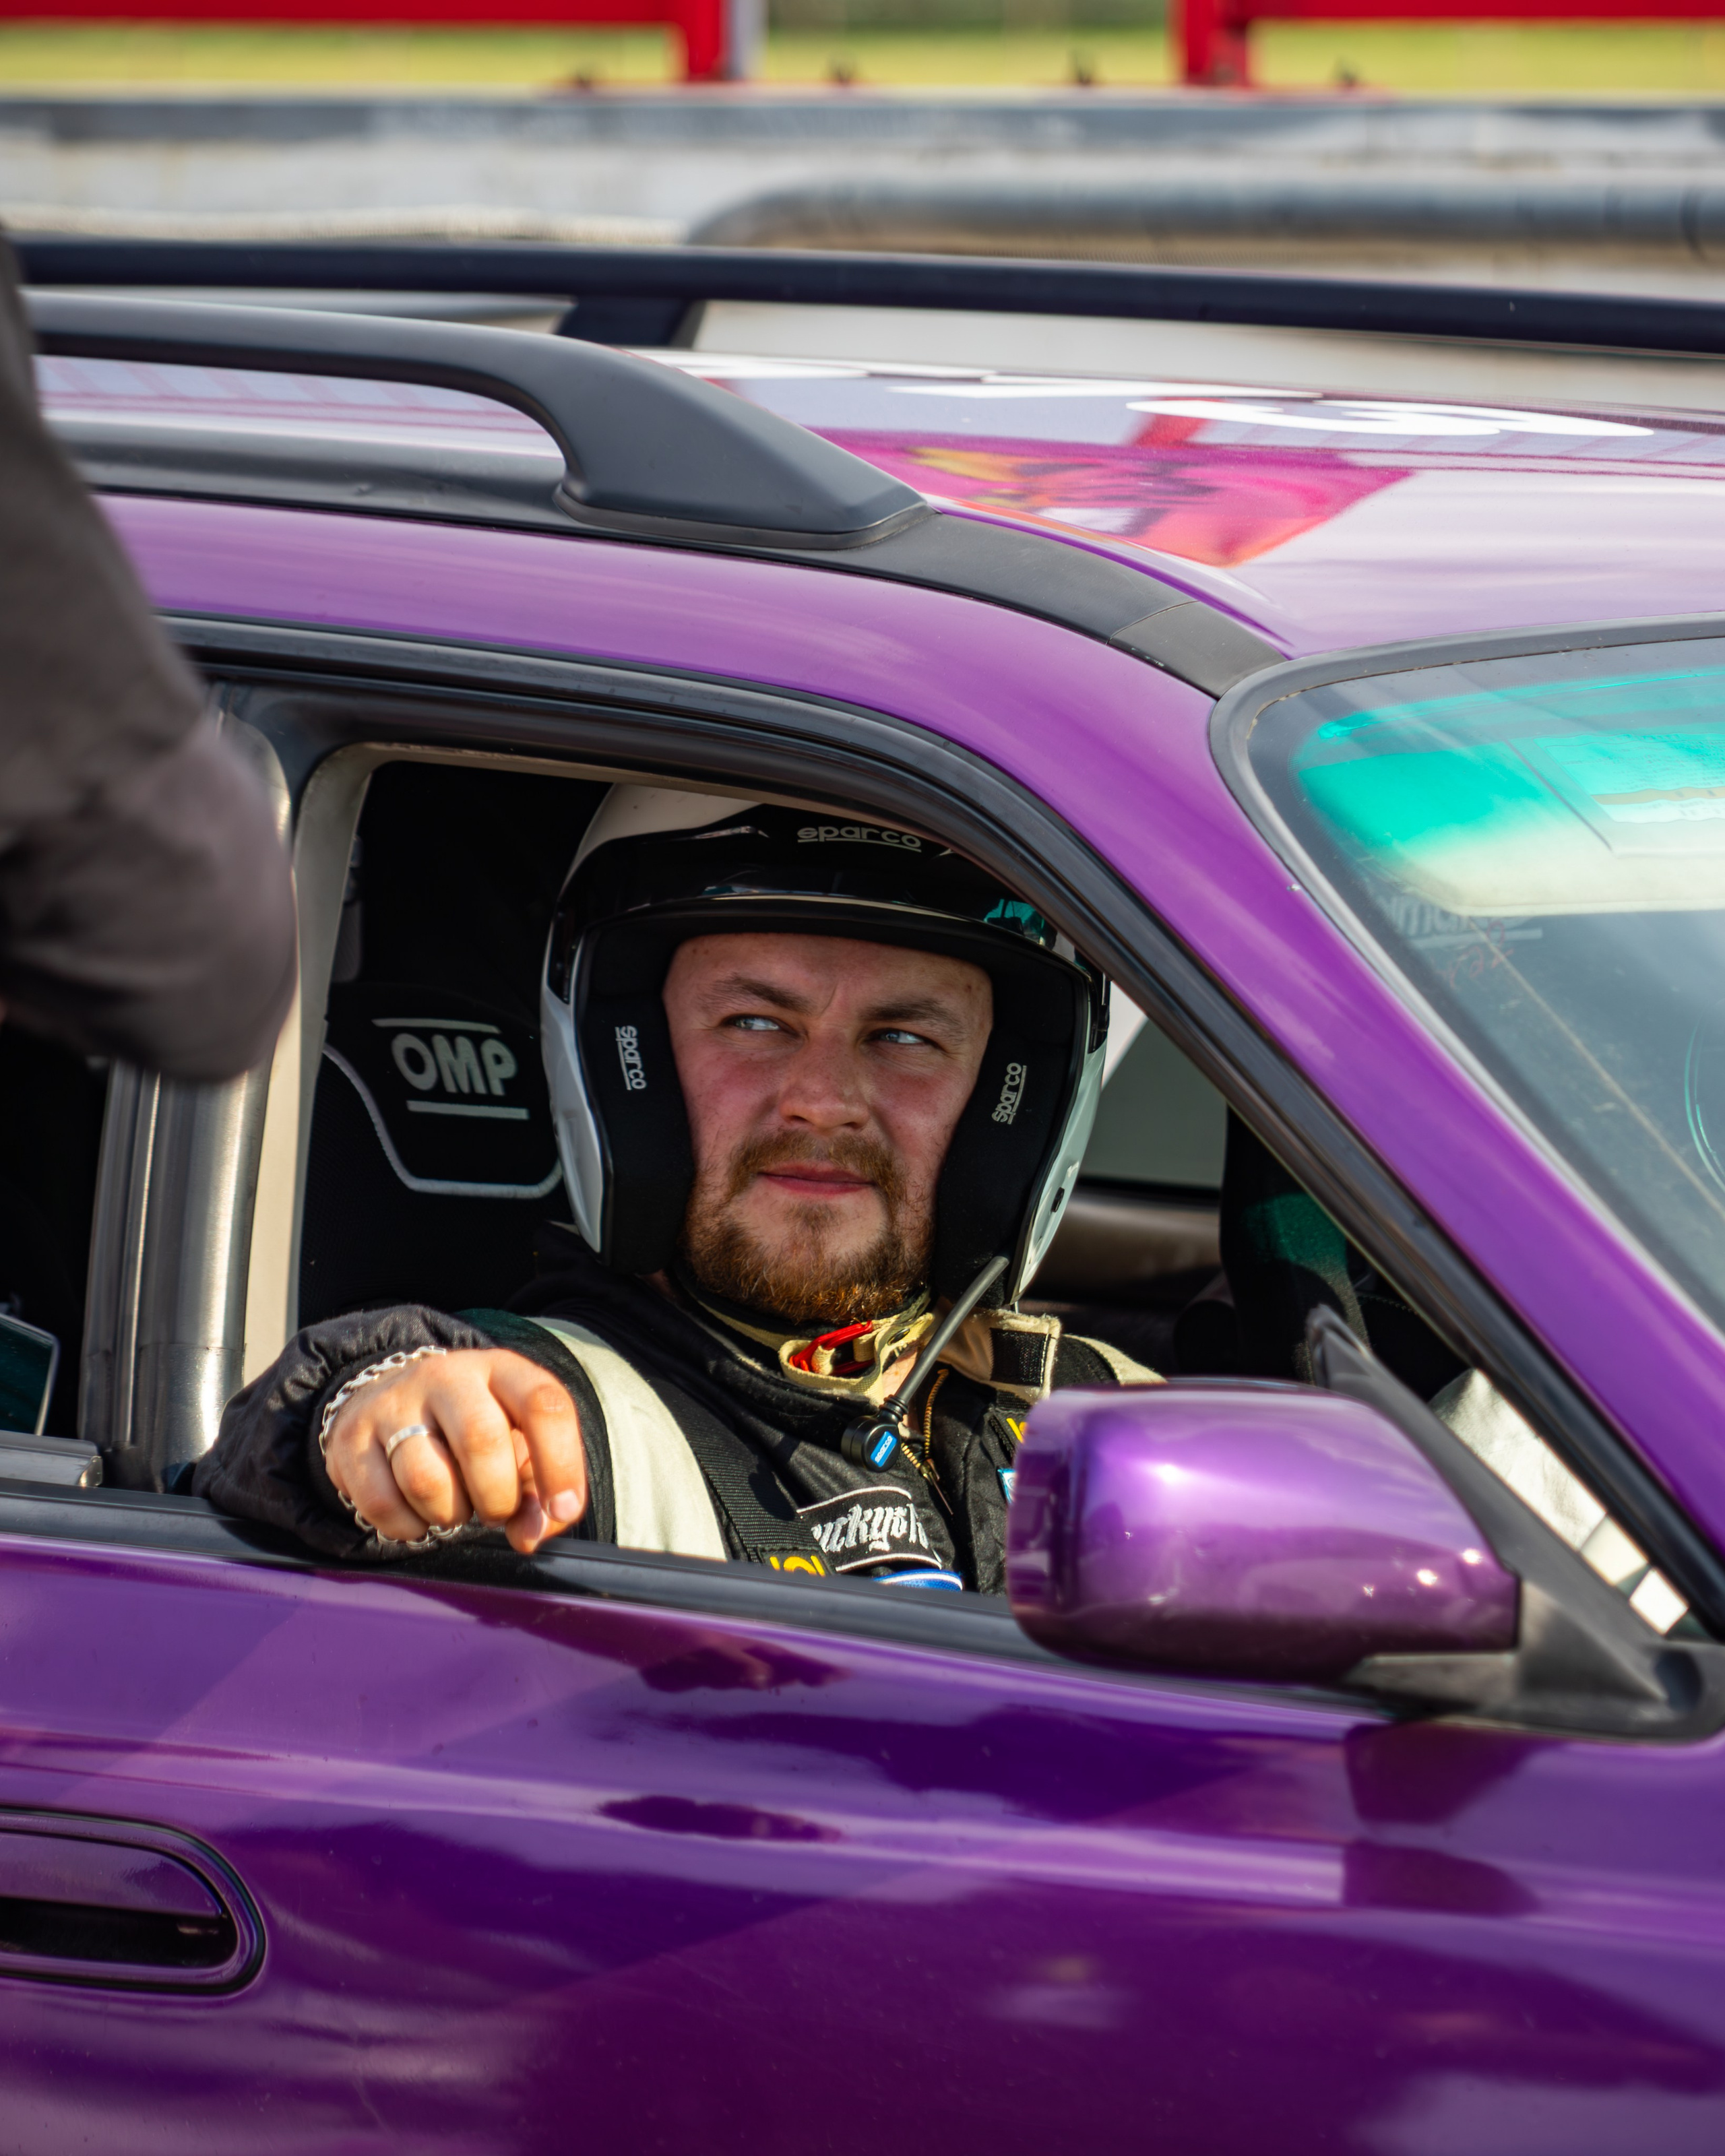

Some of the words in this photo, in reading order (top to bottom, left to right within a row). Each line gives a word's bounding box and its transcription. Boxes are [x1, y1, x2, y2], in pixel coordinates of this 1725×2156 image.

[797, 826, 921, 850] sparco
[391, 1033, 518, 1096] OMP
[615, 1025, 647, 1089] sparco
[991, 1063, 1025, 1124] sparco
